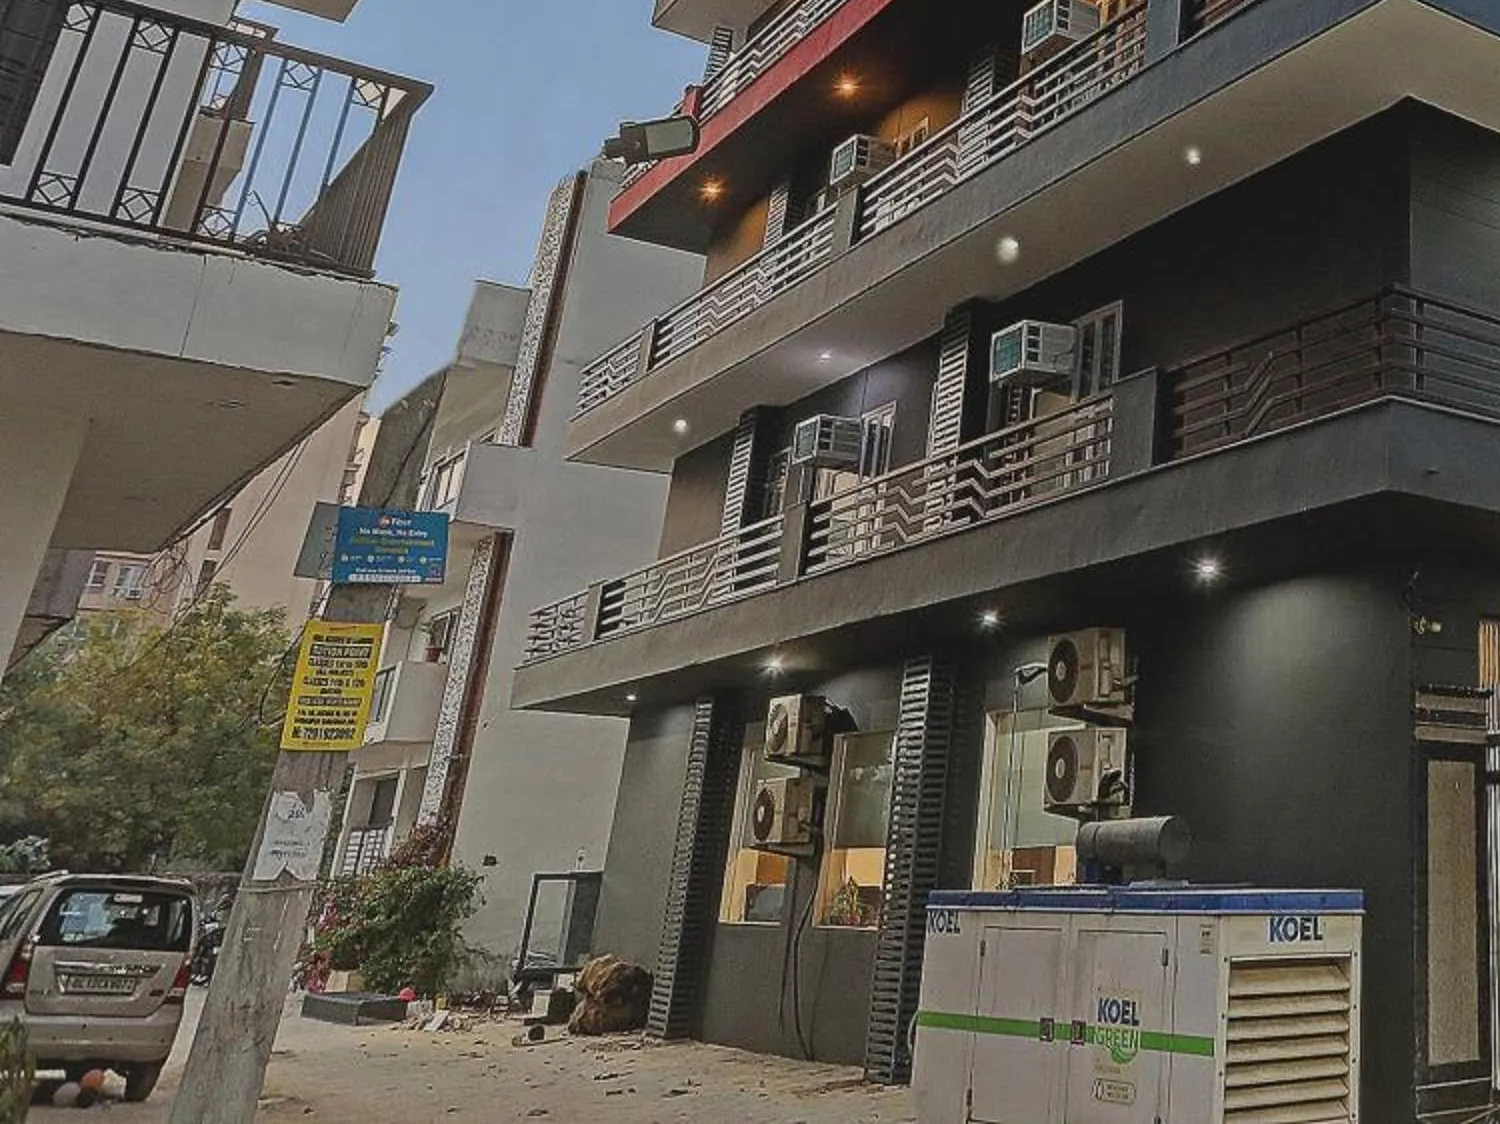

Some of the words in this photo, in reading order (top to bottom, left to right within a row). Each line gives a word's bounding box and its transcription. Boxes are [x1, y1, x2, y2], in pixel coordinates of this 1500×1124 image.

[926, 910, 961, 935] KOEL
[1269, 917, 1324, 943] KOEL
[1097, 997, 1141, 1027] KOEL
